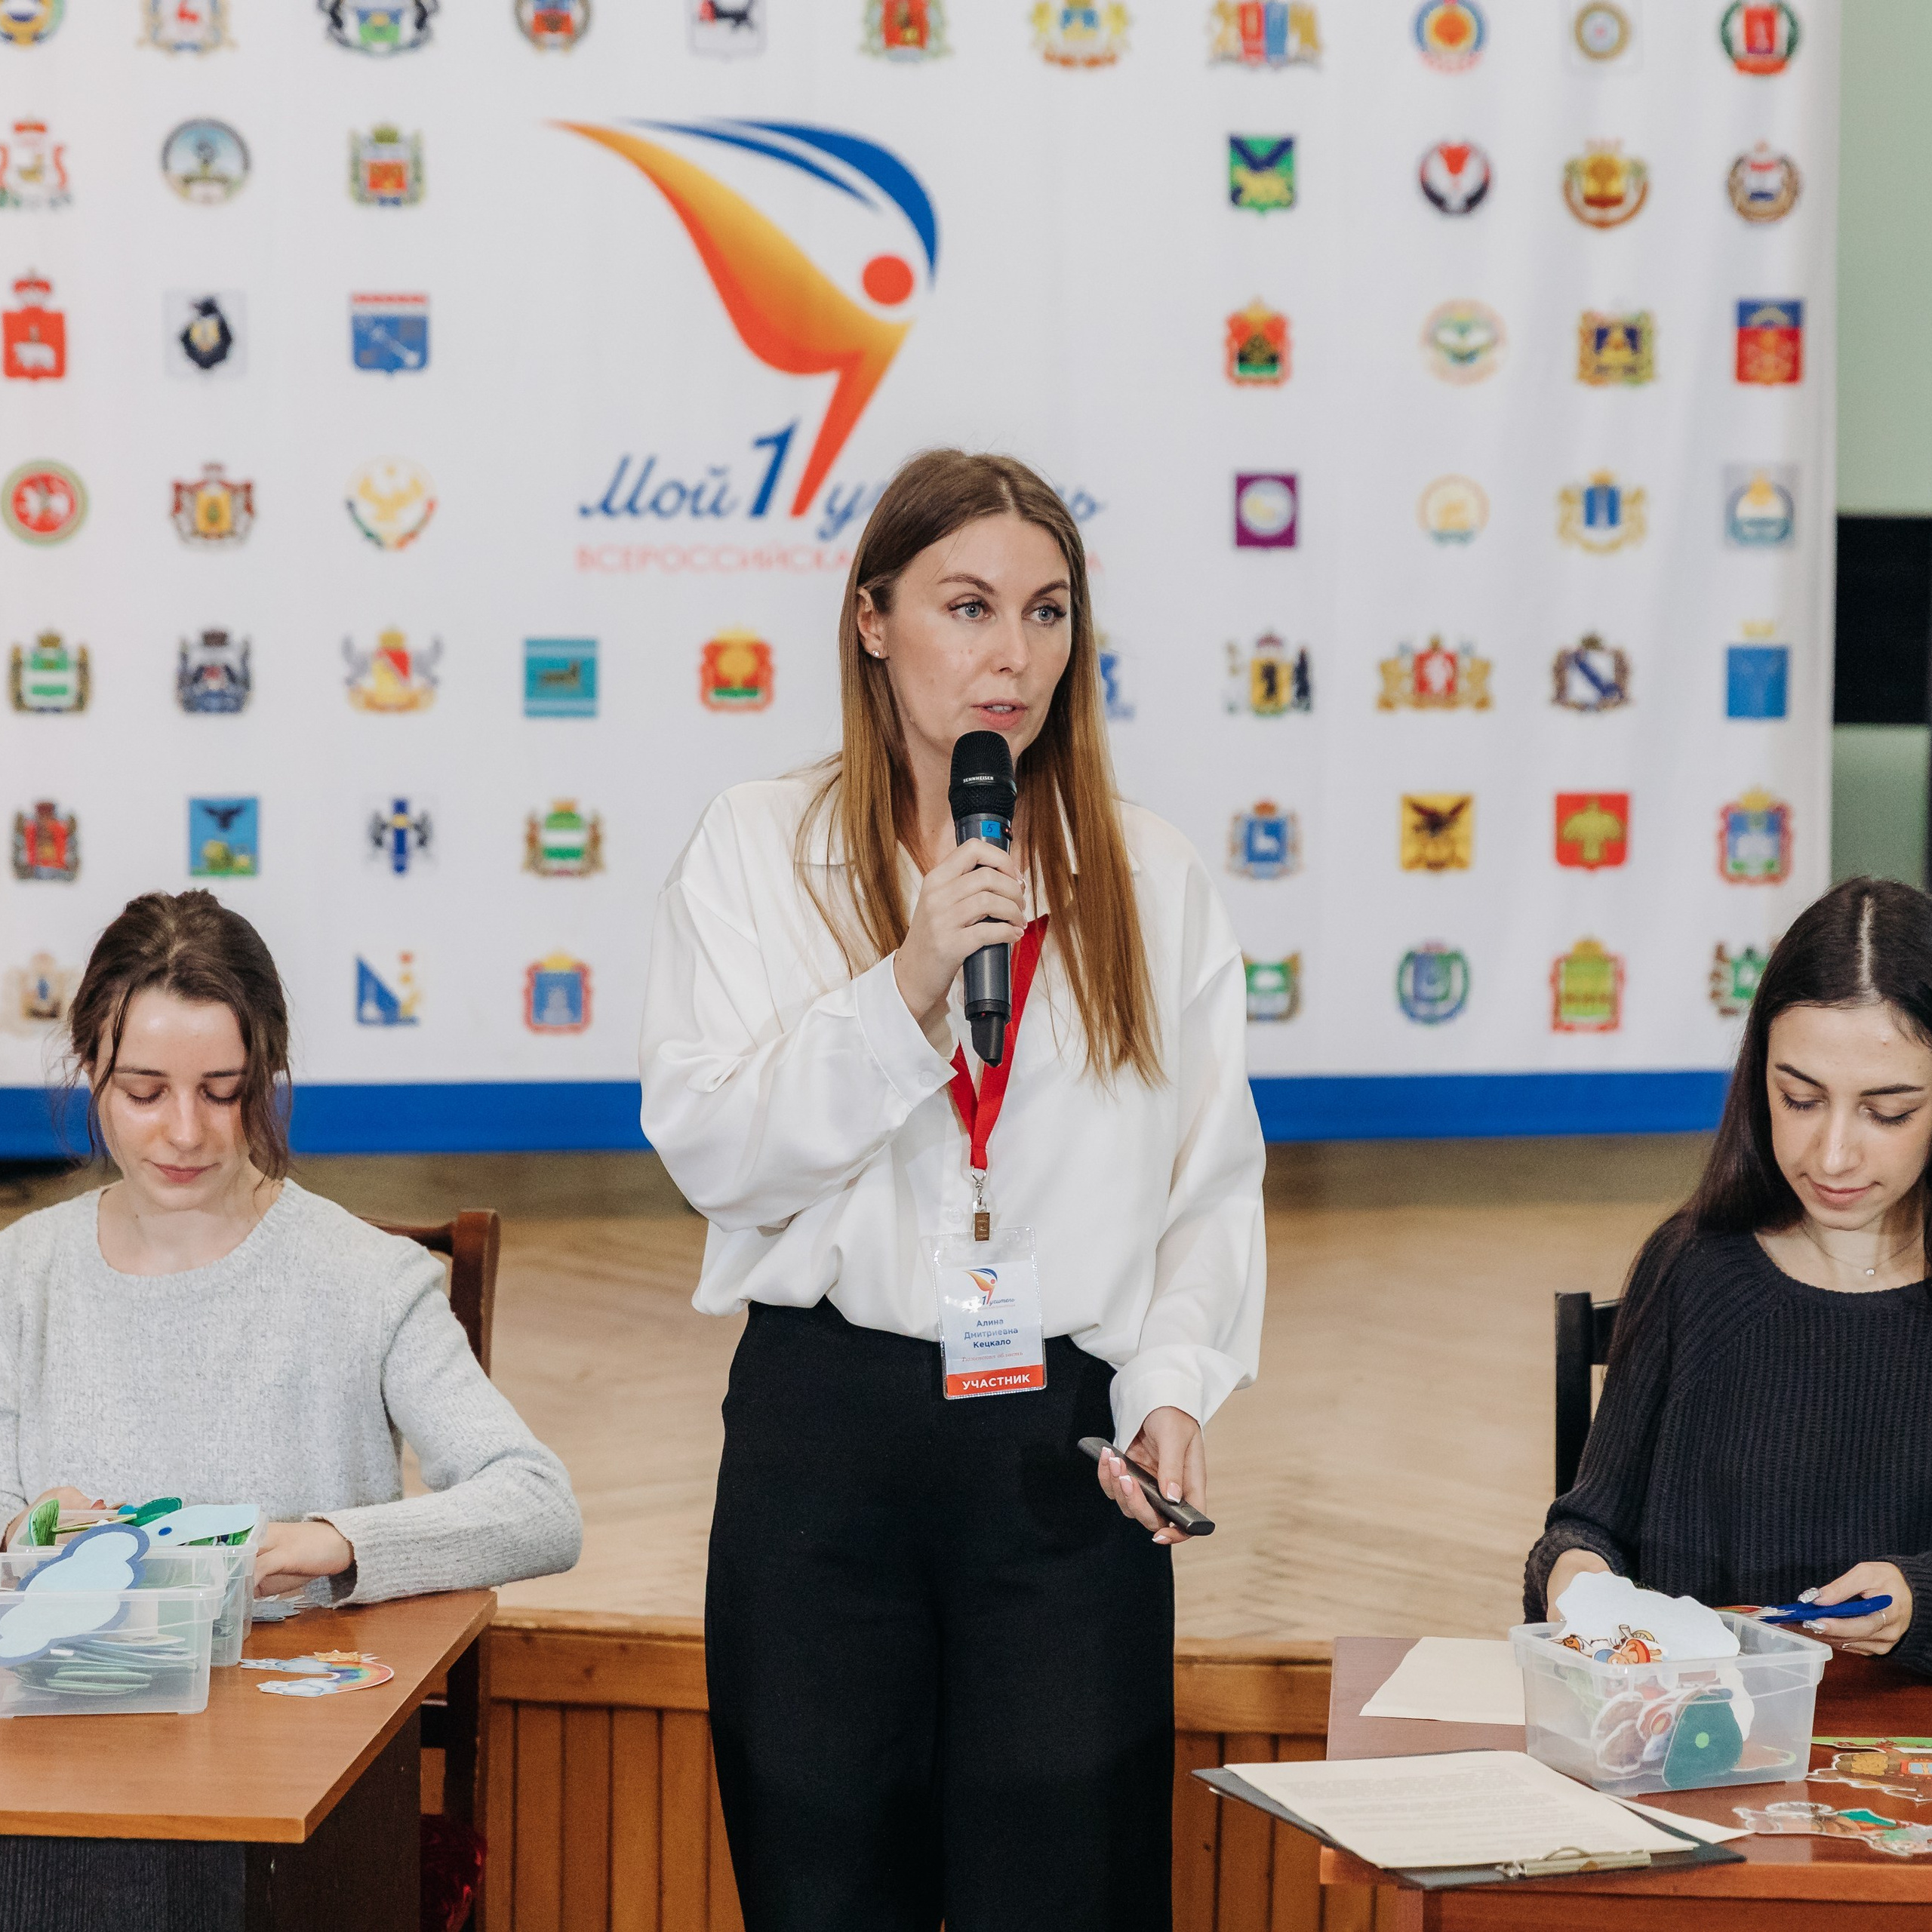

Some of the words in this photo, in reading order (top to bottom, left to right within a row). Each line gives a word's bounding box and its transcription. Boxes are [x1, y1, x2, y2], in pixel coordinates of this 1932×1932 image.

[578, 454, 737, 518] Мой
[749, 419, 800, 519] 1
[575, 543, 854, 575] ВСЕРОССИЙСКА
[986, 823, 995, 833] 5
[977, 1318, 1004, 1327] Алина
[964, 1327, 1019, 1340] Дмитриевна
[973, 1339, 1011, 1349] Кецкало
[962, 1374, 1031, 1390] УЧАСТНИК
